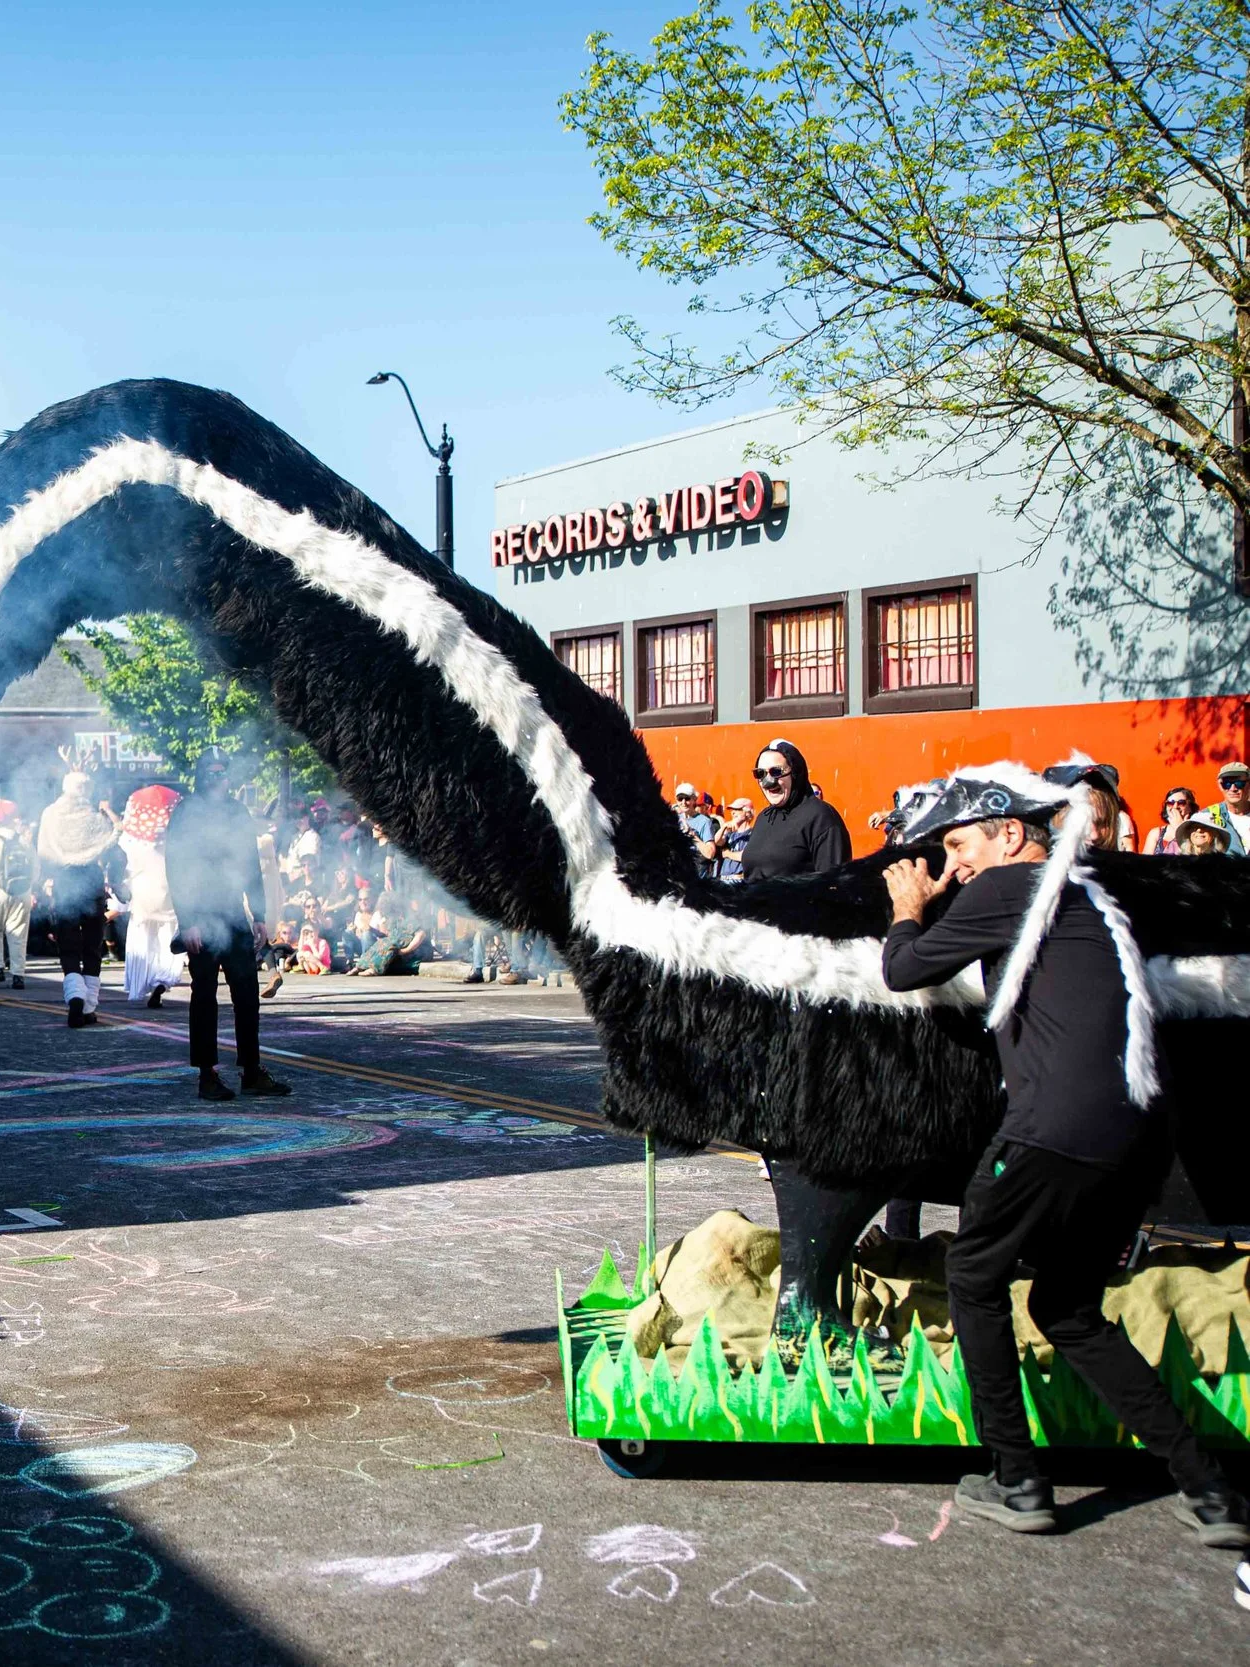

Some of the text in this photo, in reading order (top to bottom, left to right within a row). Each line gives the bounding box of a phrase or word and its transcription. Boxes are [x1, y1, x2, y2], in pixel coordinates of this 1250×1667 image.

[490, 470, 766, 567] RECORDS & VIDEO
